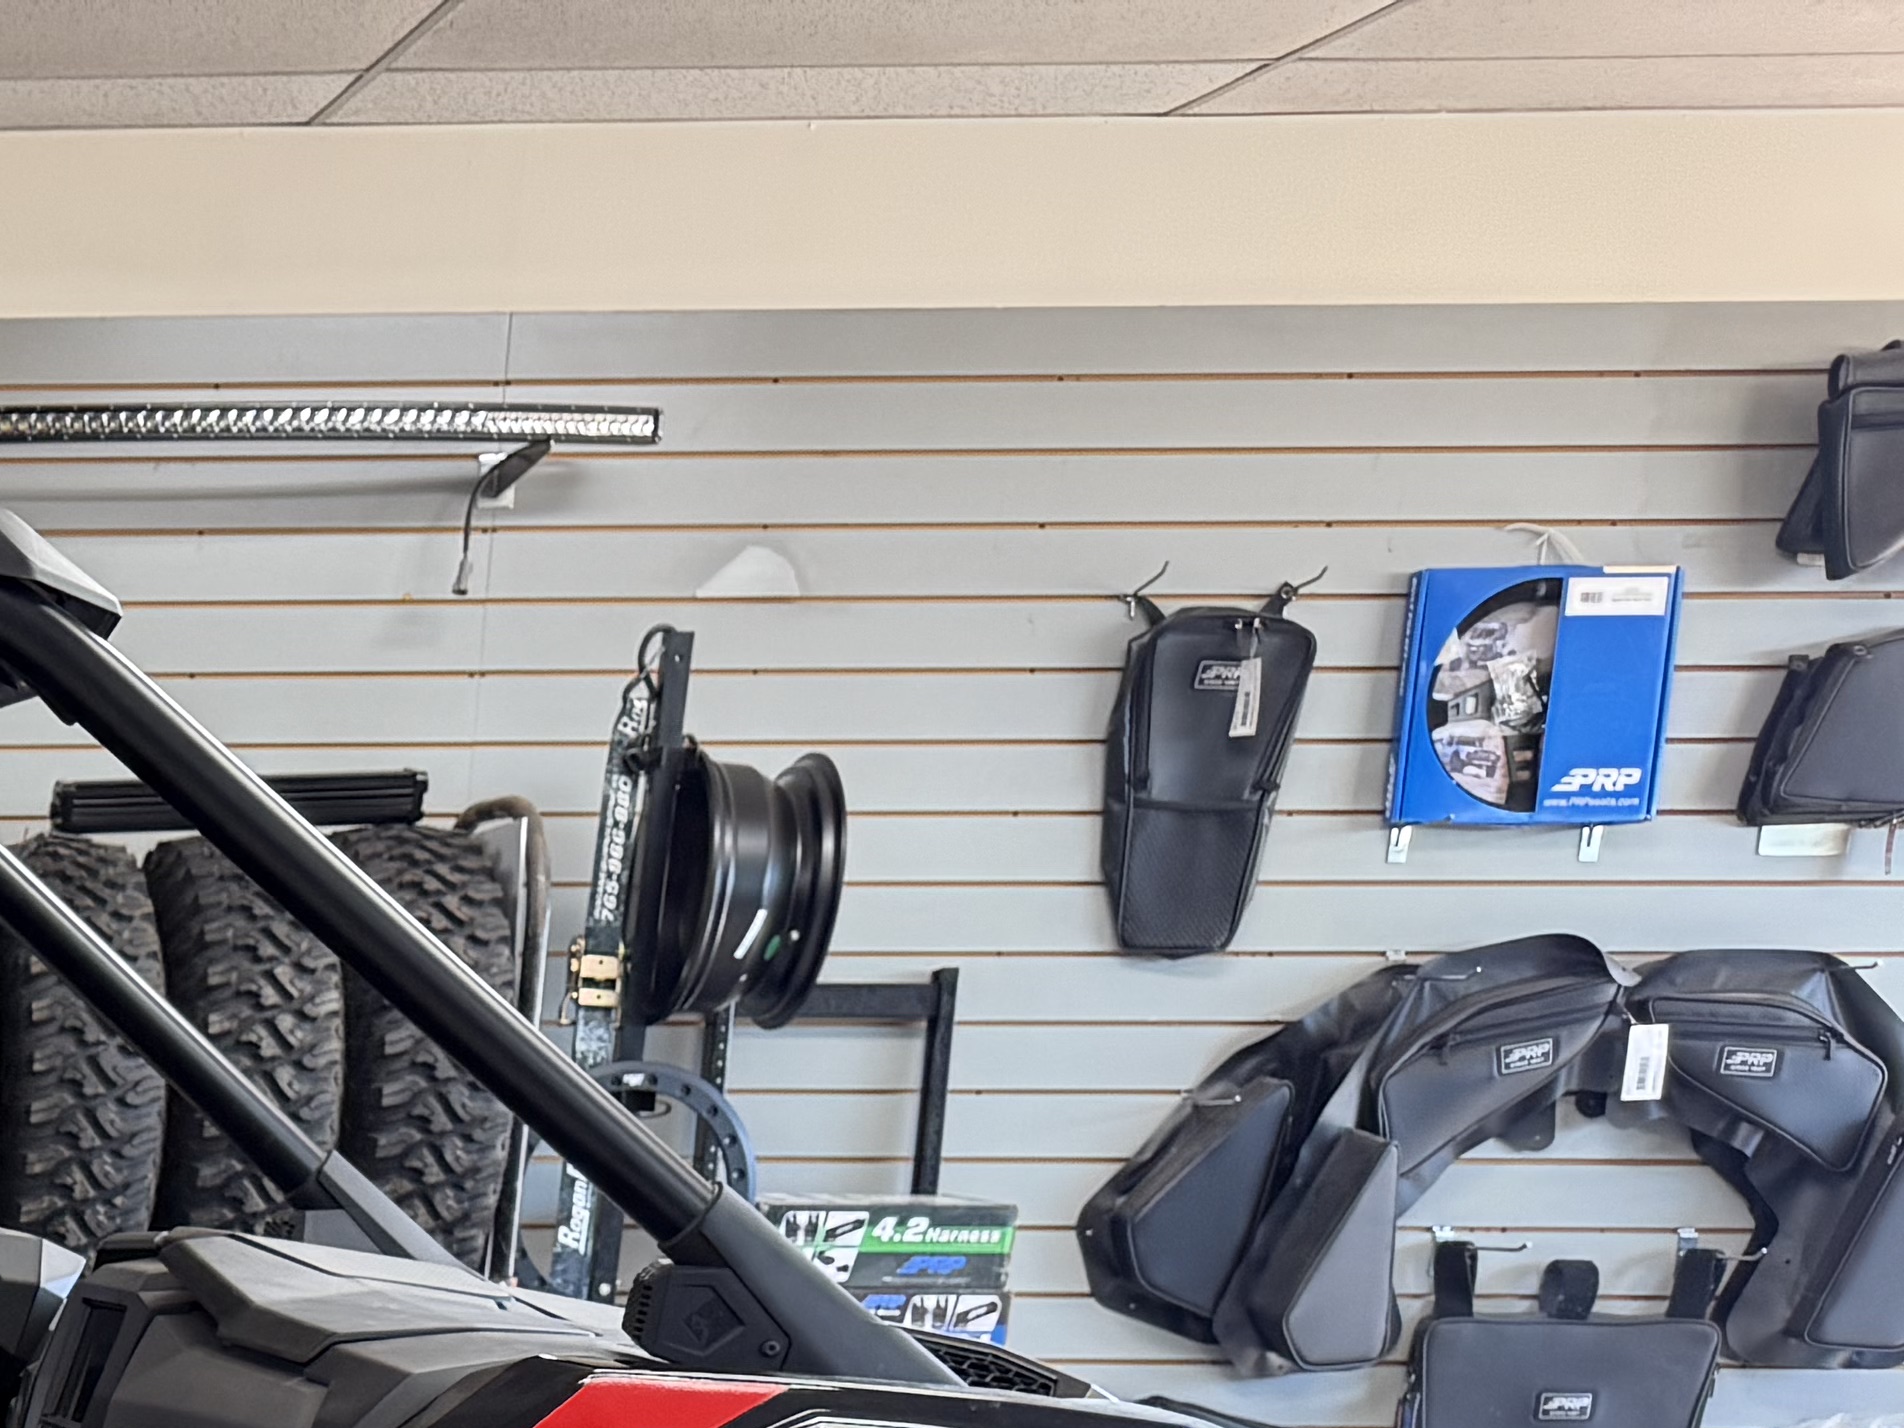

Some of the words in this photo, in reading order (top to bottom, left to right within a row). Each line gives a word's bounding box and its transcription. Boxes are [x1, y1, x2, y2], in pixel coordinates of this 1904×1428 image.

[1551, 767, 1642, 792] PRP
[872, 1216, 930, 1243] 4.2
[925, 1228, 1001, 1243] Harness
